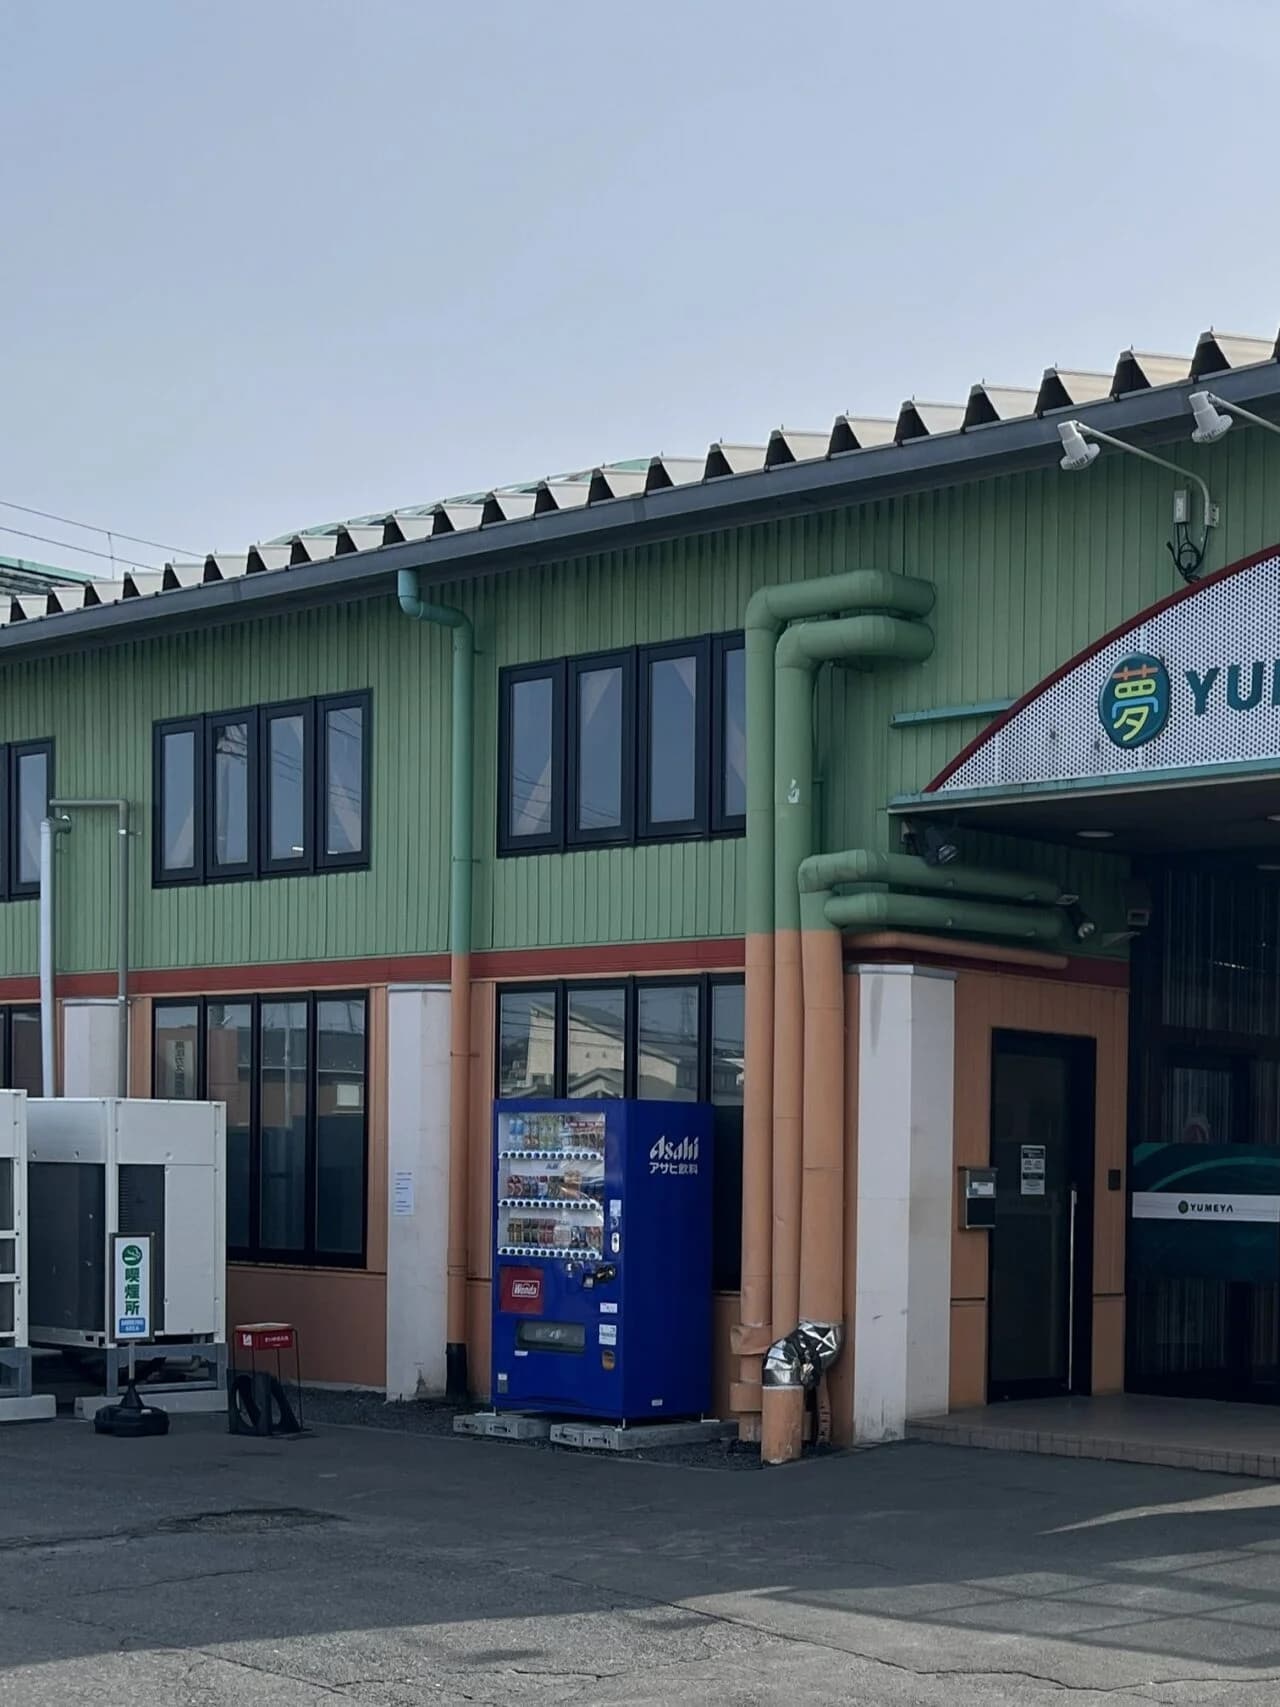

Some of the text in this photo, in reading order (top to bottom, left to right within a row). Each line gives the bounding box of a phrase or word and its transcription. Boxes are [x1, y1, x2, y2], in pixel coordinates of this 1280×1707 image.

[1111, 663, 1160, 743] 夢
[649, 1135, 700, 1161] Asahi
[649, 1161, 699, 1176] アサヒ飲料
[1190, 1203, 1234, 1213] YUMEYA
[124, 1267, 140, 1316] 喫煙所
